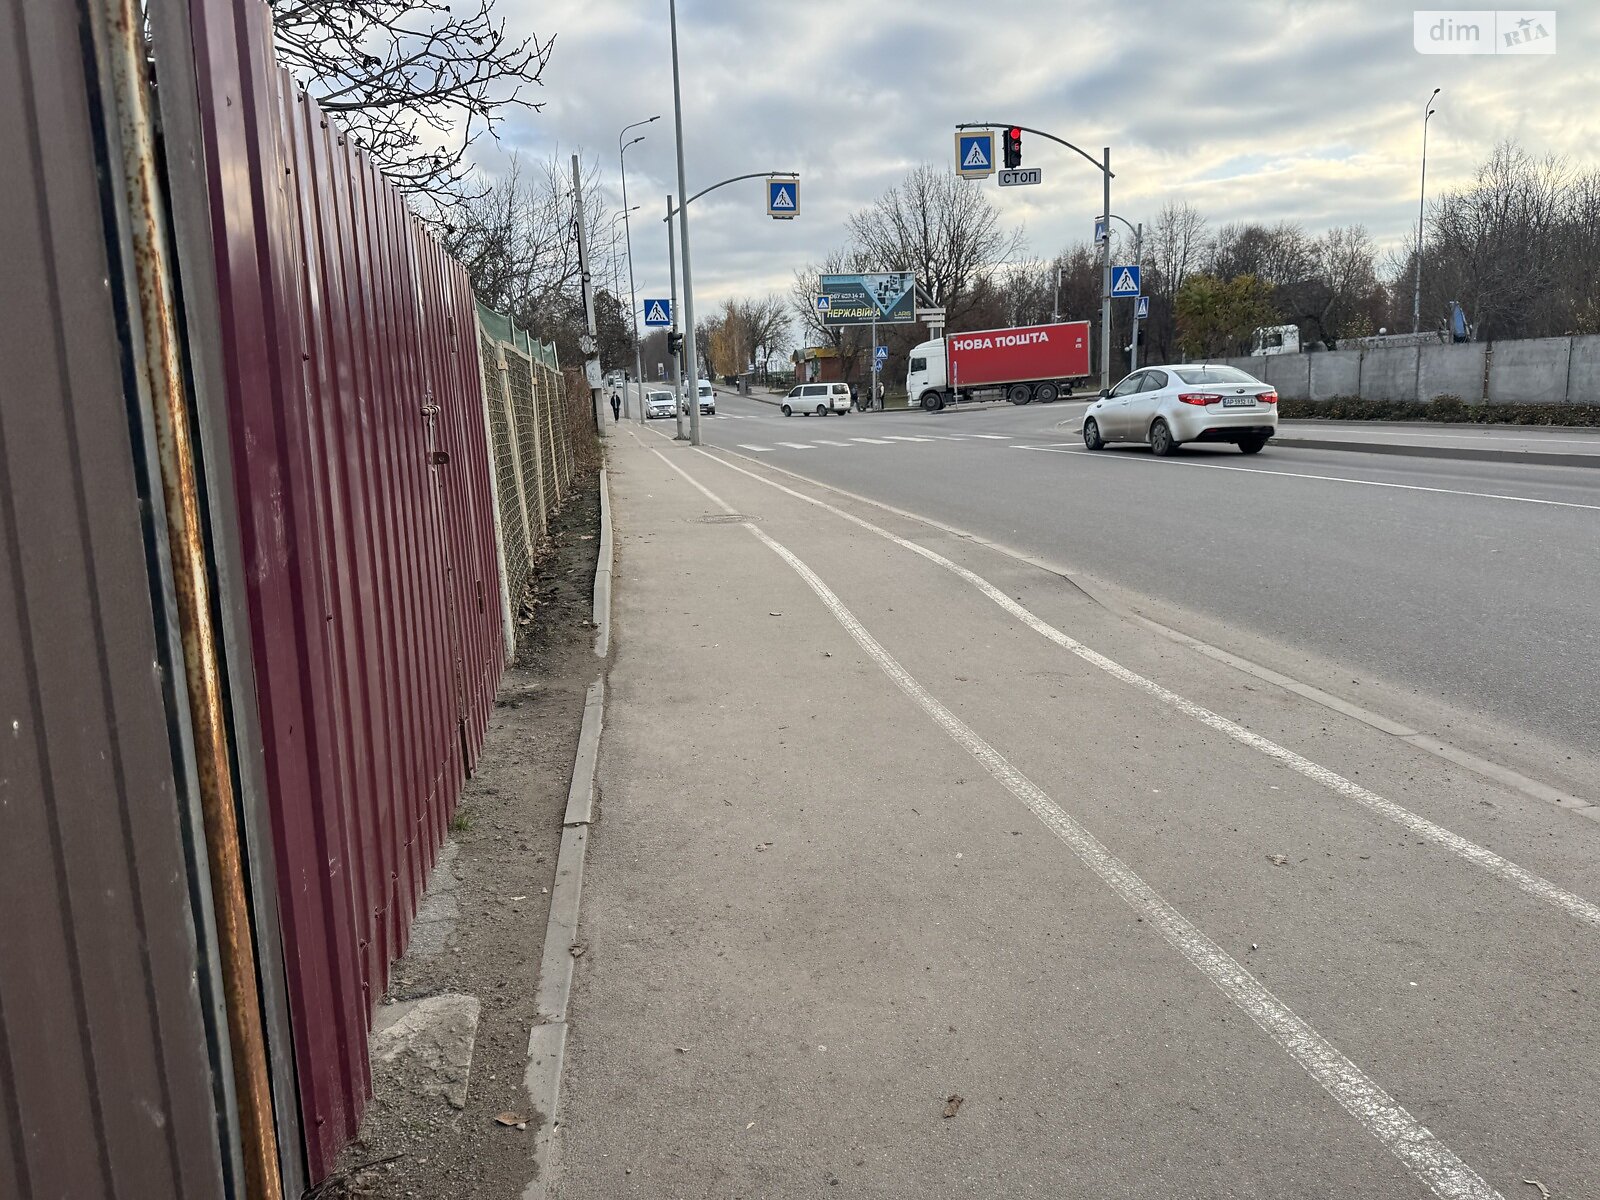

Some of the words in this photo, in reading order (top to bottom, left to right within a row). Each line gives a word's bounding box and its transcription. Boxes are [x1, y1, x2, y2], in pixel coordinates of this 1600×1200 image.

[1014, 142, 1020, 151] 6
[1003, 171, 1037, 184] СТОП
[953, 338, 993, 351] НОВА
[995, 331, 1049, 348] ПОШТА
